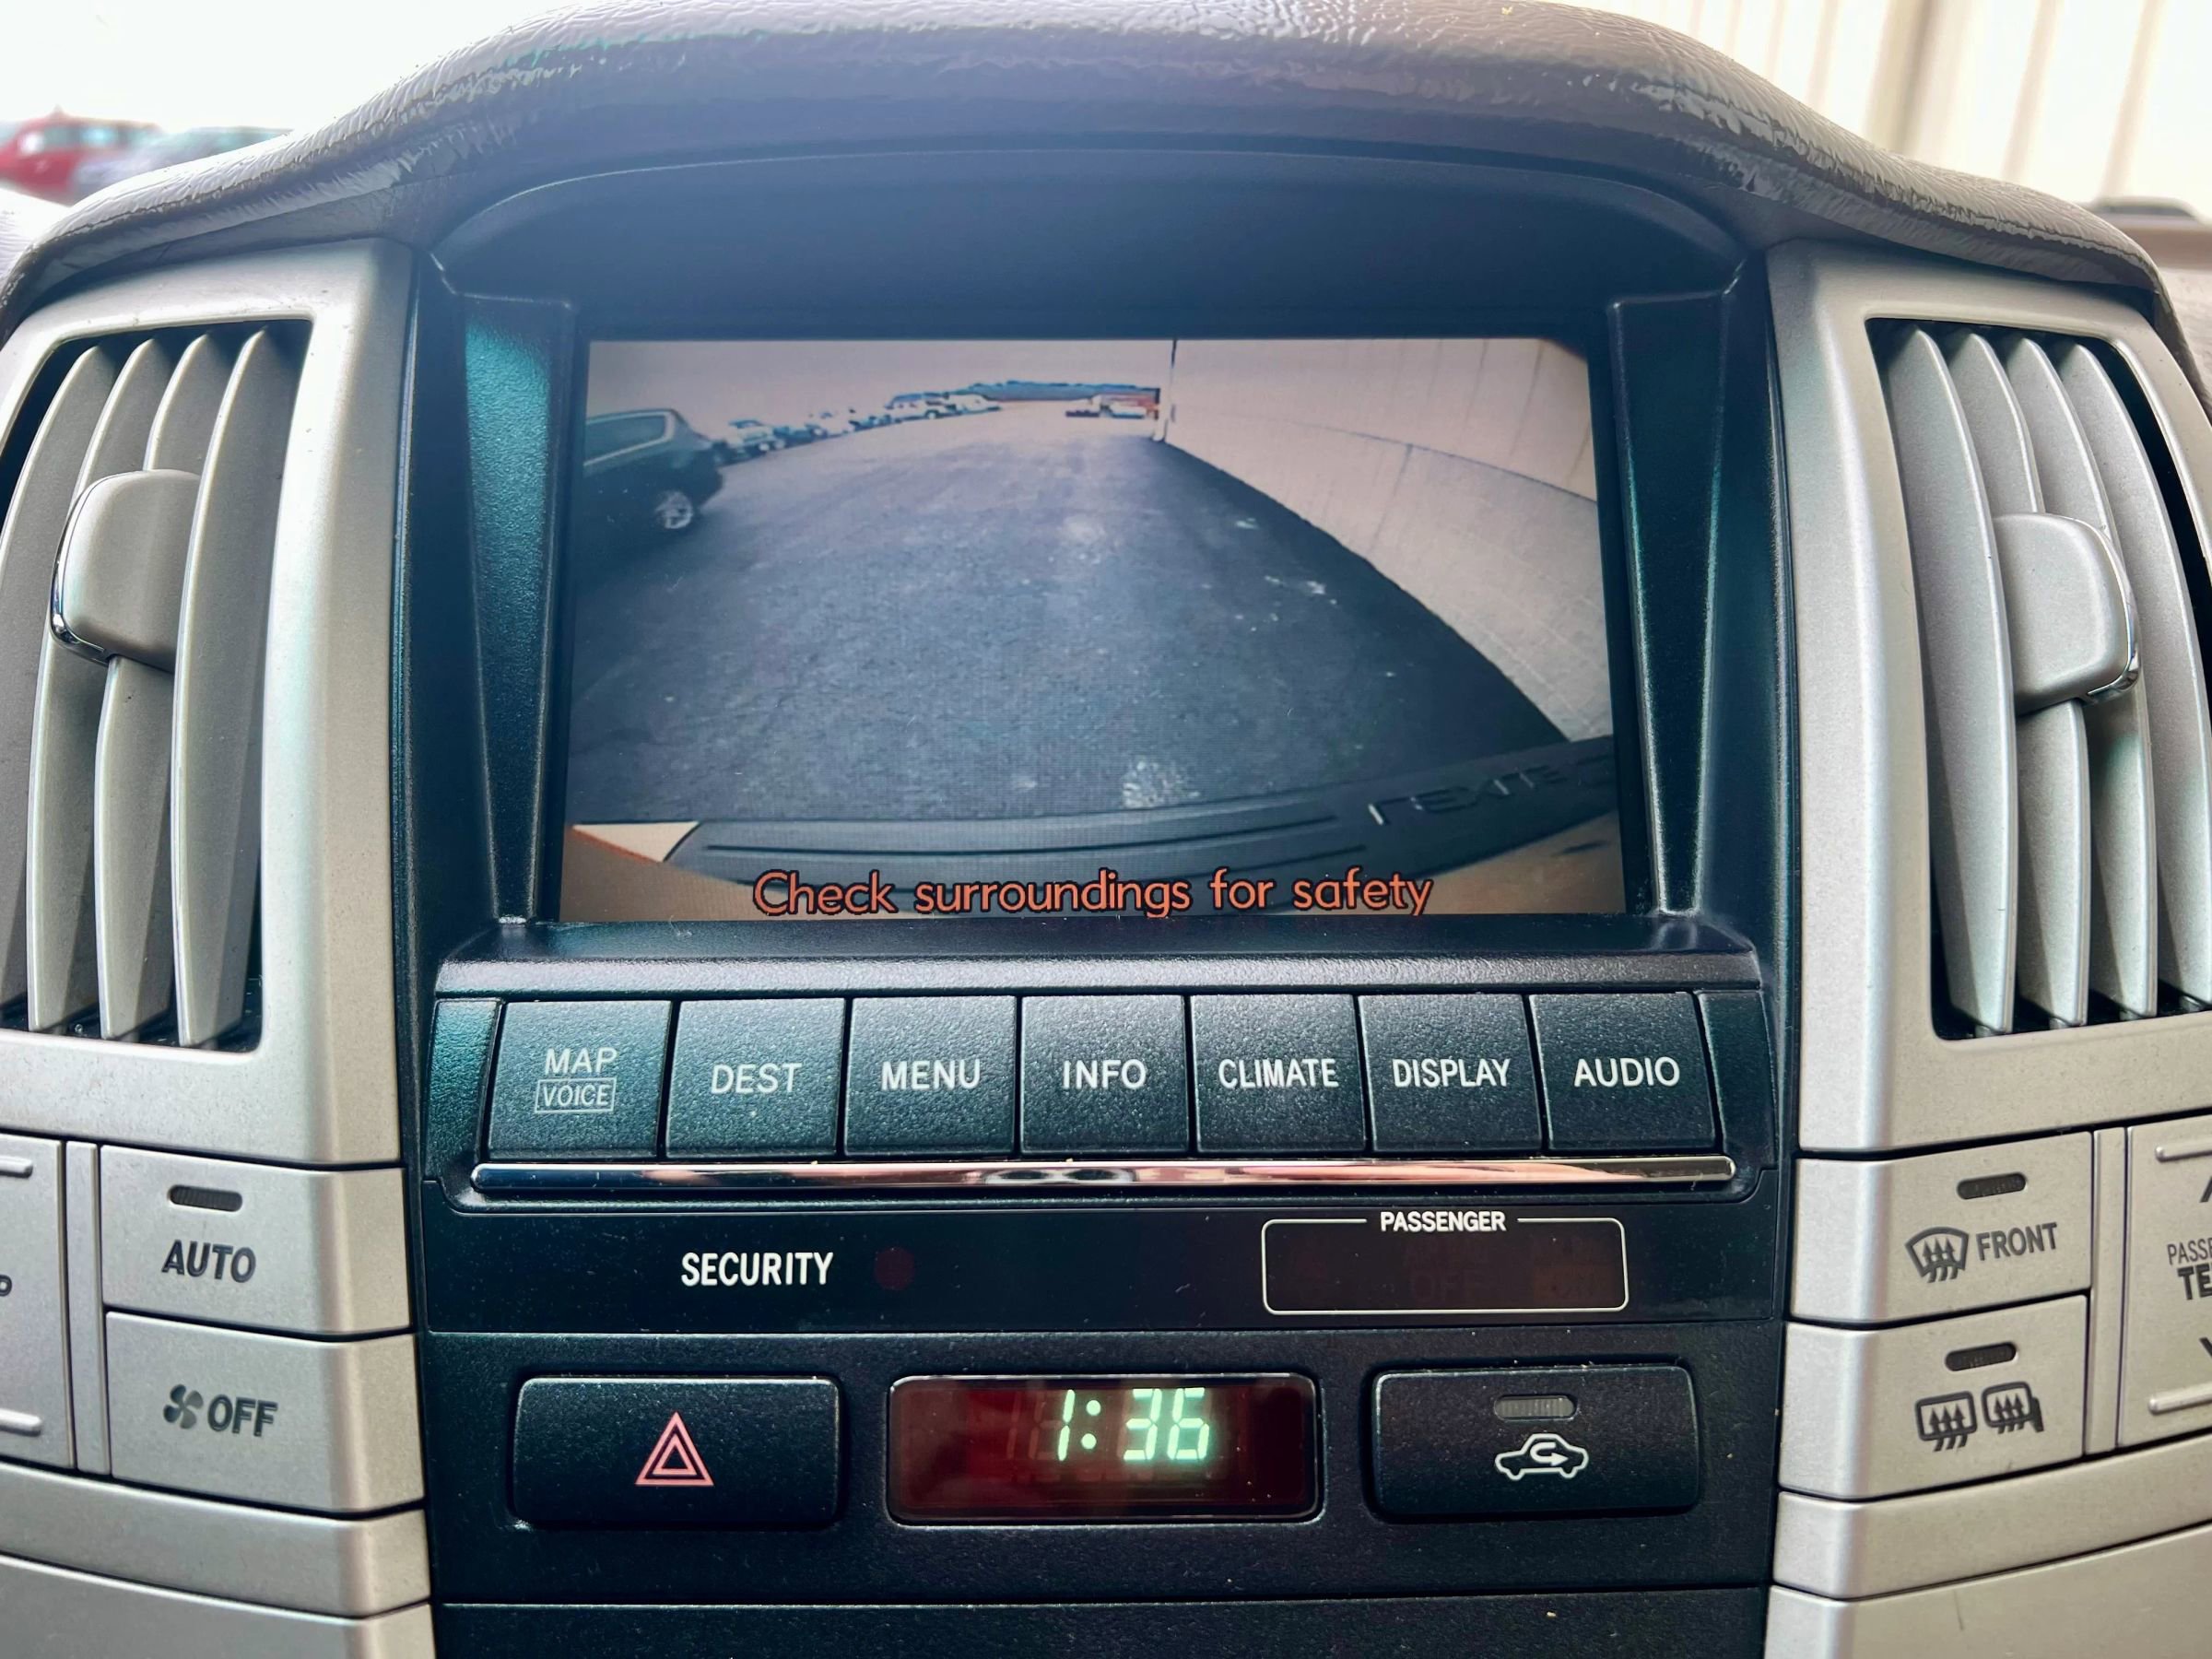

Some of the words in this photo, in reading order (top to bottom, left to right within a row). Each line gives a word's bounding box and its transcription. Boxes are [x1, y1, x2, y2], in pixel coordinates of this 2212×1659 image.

[754, 871, 894, 915] Check
[915, 868, 1192, 919] surroundings
[1210, 867, 1274, 910] for
[1292, 866, 1432, 917] safety
[544, 1047, 618, 1075] MAP
[880, 1058, 982, 1091] MENU
[1062, 1058, 1148, 1090] INFO
[1218, 1057, 1339, 1089] CLIMATE
[1392, 1057, 1512, 1088] DISPLAY
[1574, 1055, 1681, 1088] AUDIO
[710, 1061, 804, 1095] DEST
[542, 1083, 610, 1108] VOICE
[1379, 1210, 1507, 1233] PASSENGER
[1975, 1221, 2058, 1262] FRONT
[160, 1240, 256, 1284] AUTO
[680, 1251, 835, 1288] SECURITY
[207, 1394, 278, 1438] OFF
[1056, 1386, 1211, 1463] 1:36
